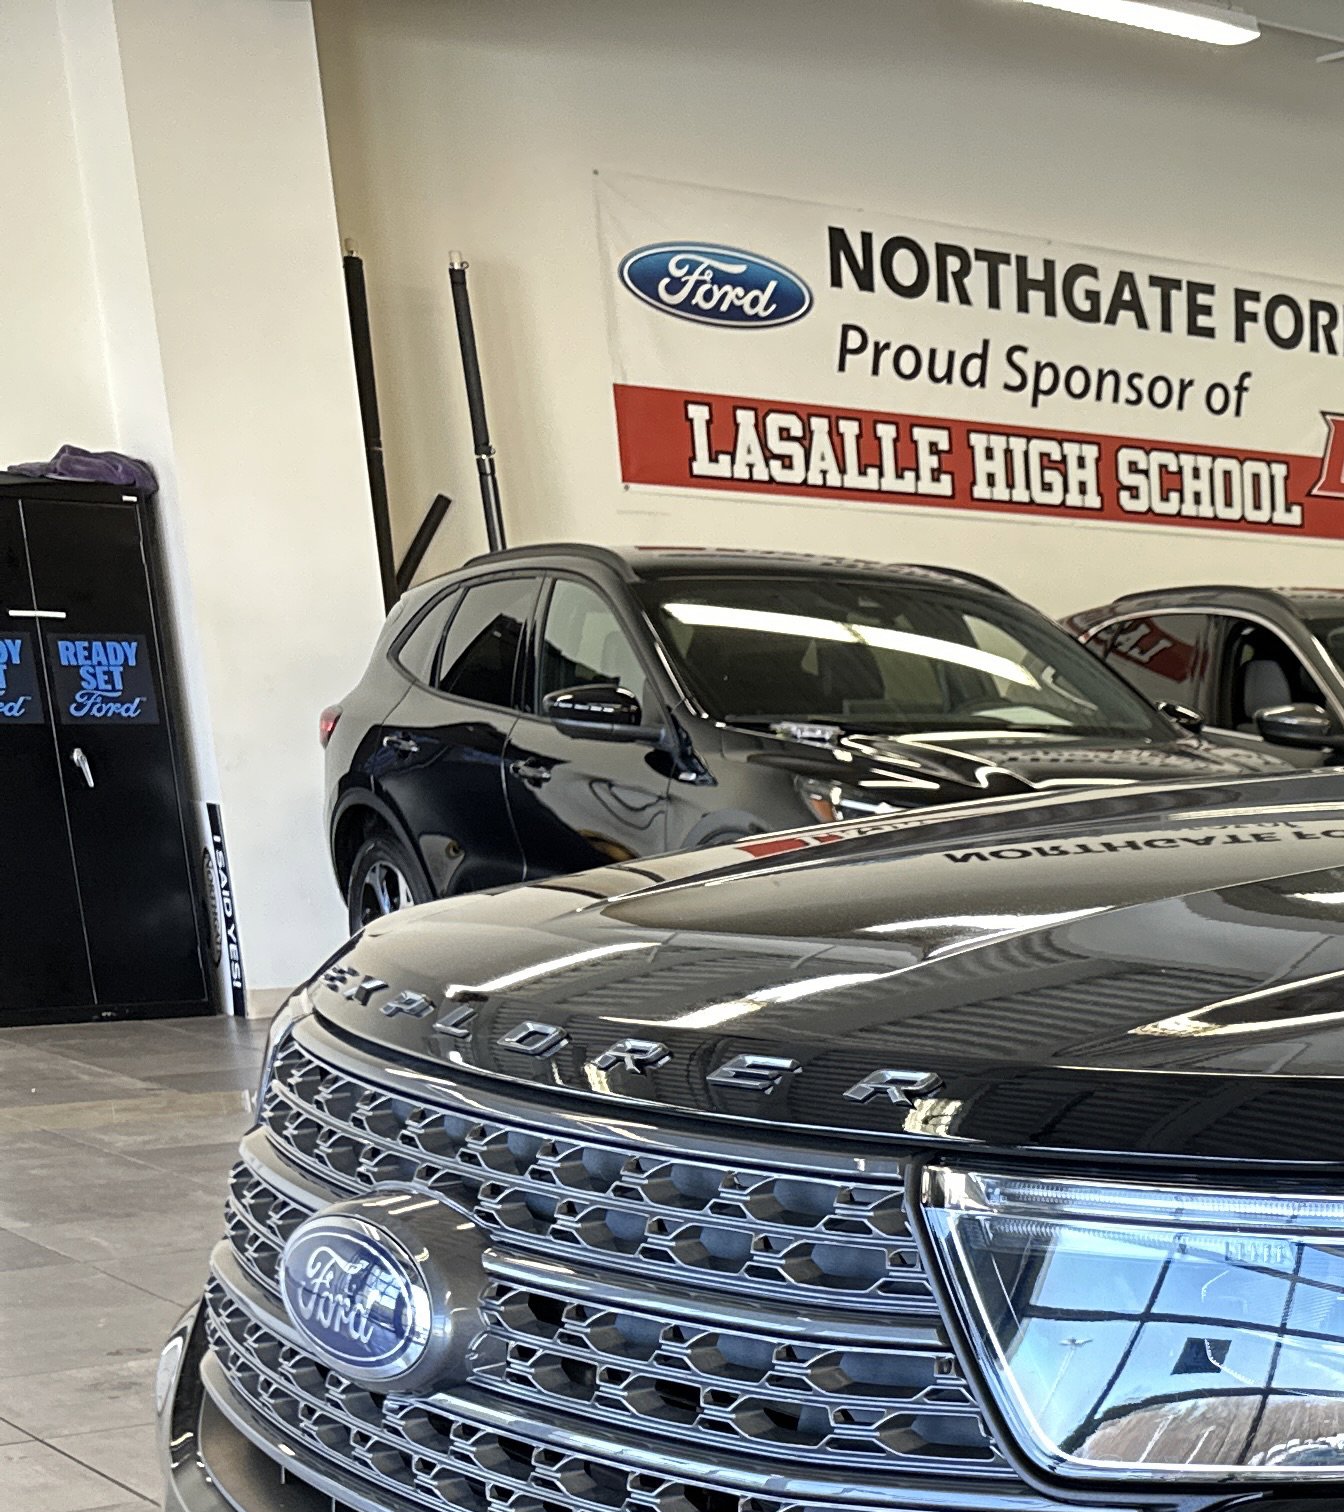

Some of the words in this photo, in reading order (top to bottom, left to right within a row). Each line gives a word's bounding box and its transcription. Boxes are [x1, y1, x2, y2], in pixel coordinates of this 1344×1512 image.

[657, 254, 777, 318] Ford
[827, 226, 1217, 340] NORTHGATE
[836, 324, 990, 390] Proud
[1003, 344, 1193, 408] Sponsor
[1205, 372, 1252, 418] of
[685, 402, 952, 496] LASALLE
[969, 431, 1103, 510] HIGH
[1115, 445, 1303, 528] SCHOOL
[57, 640, 138, 667] READY
[79, 665, 123, 691] SET
[69, 689, 142, 718] Ford
[215, 849, 233, 918] SAID
[298, 1246, 375, 1344] Ford
